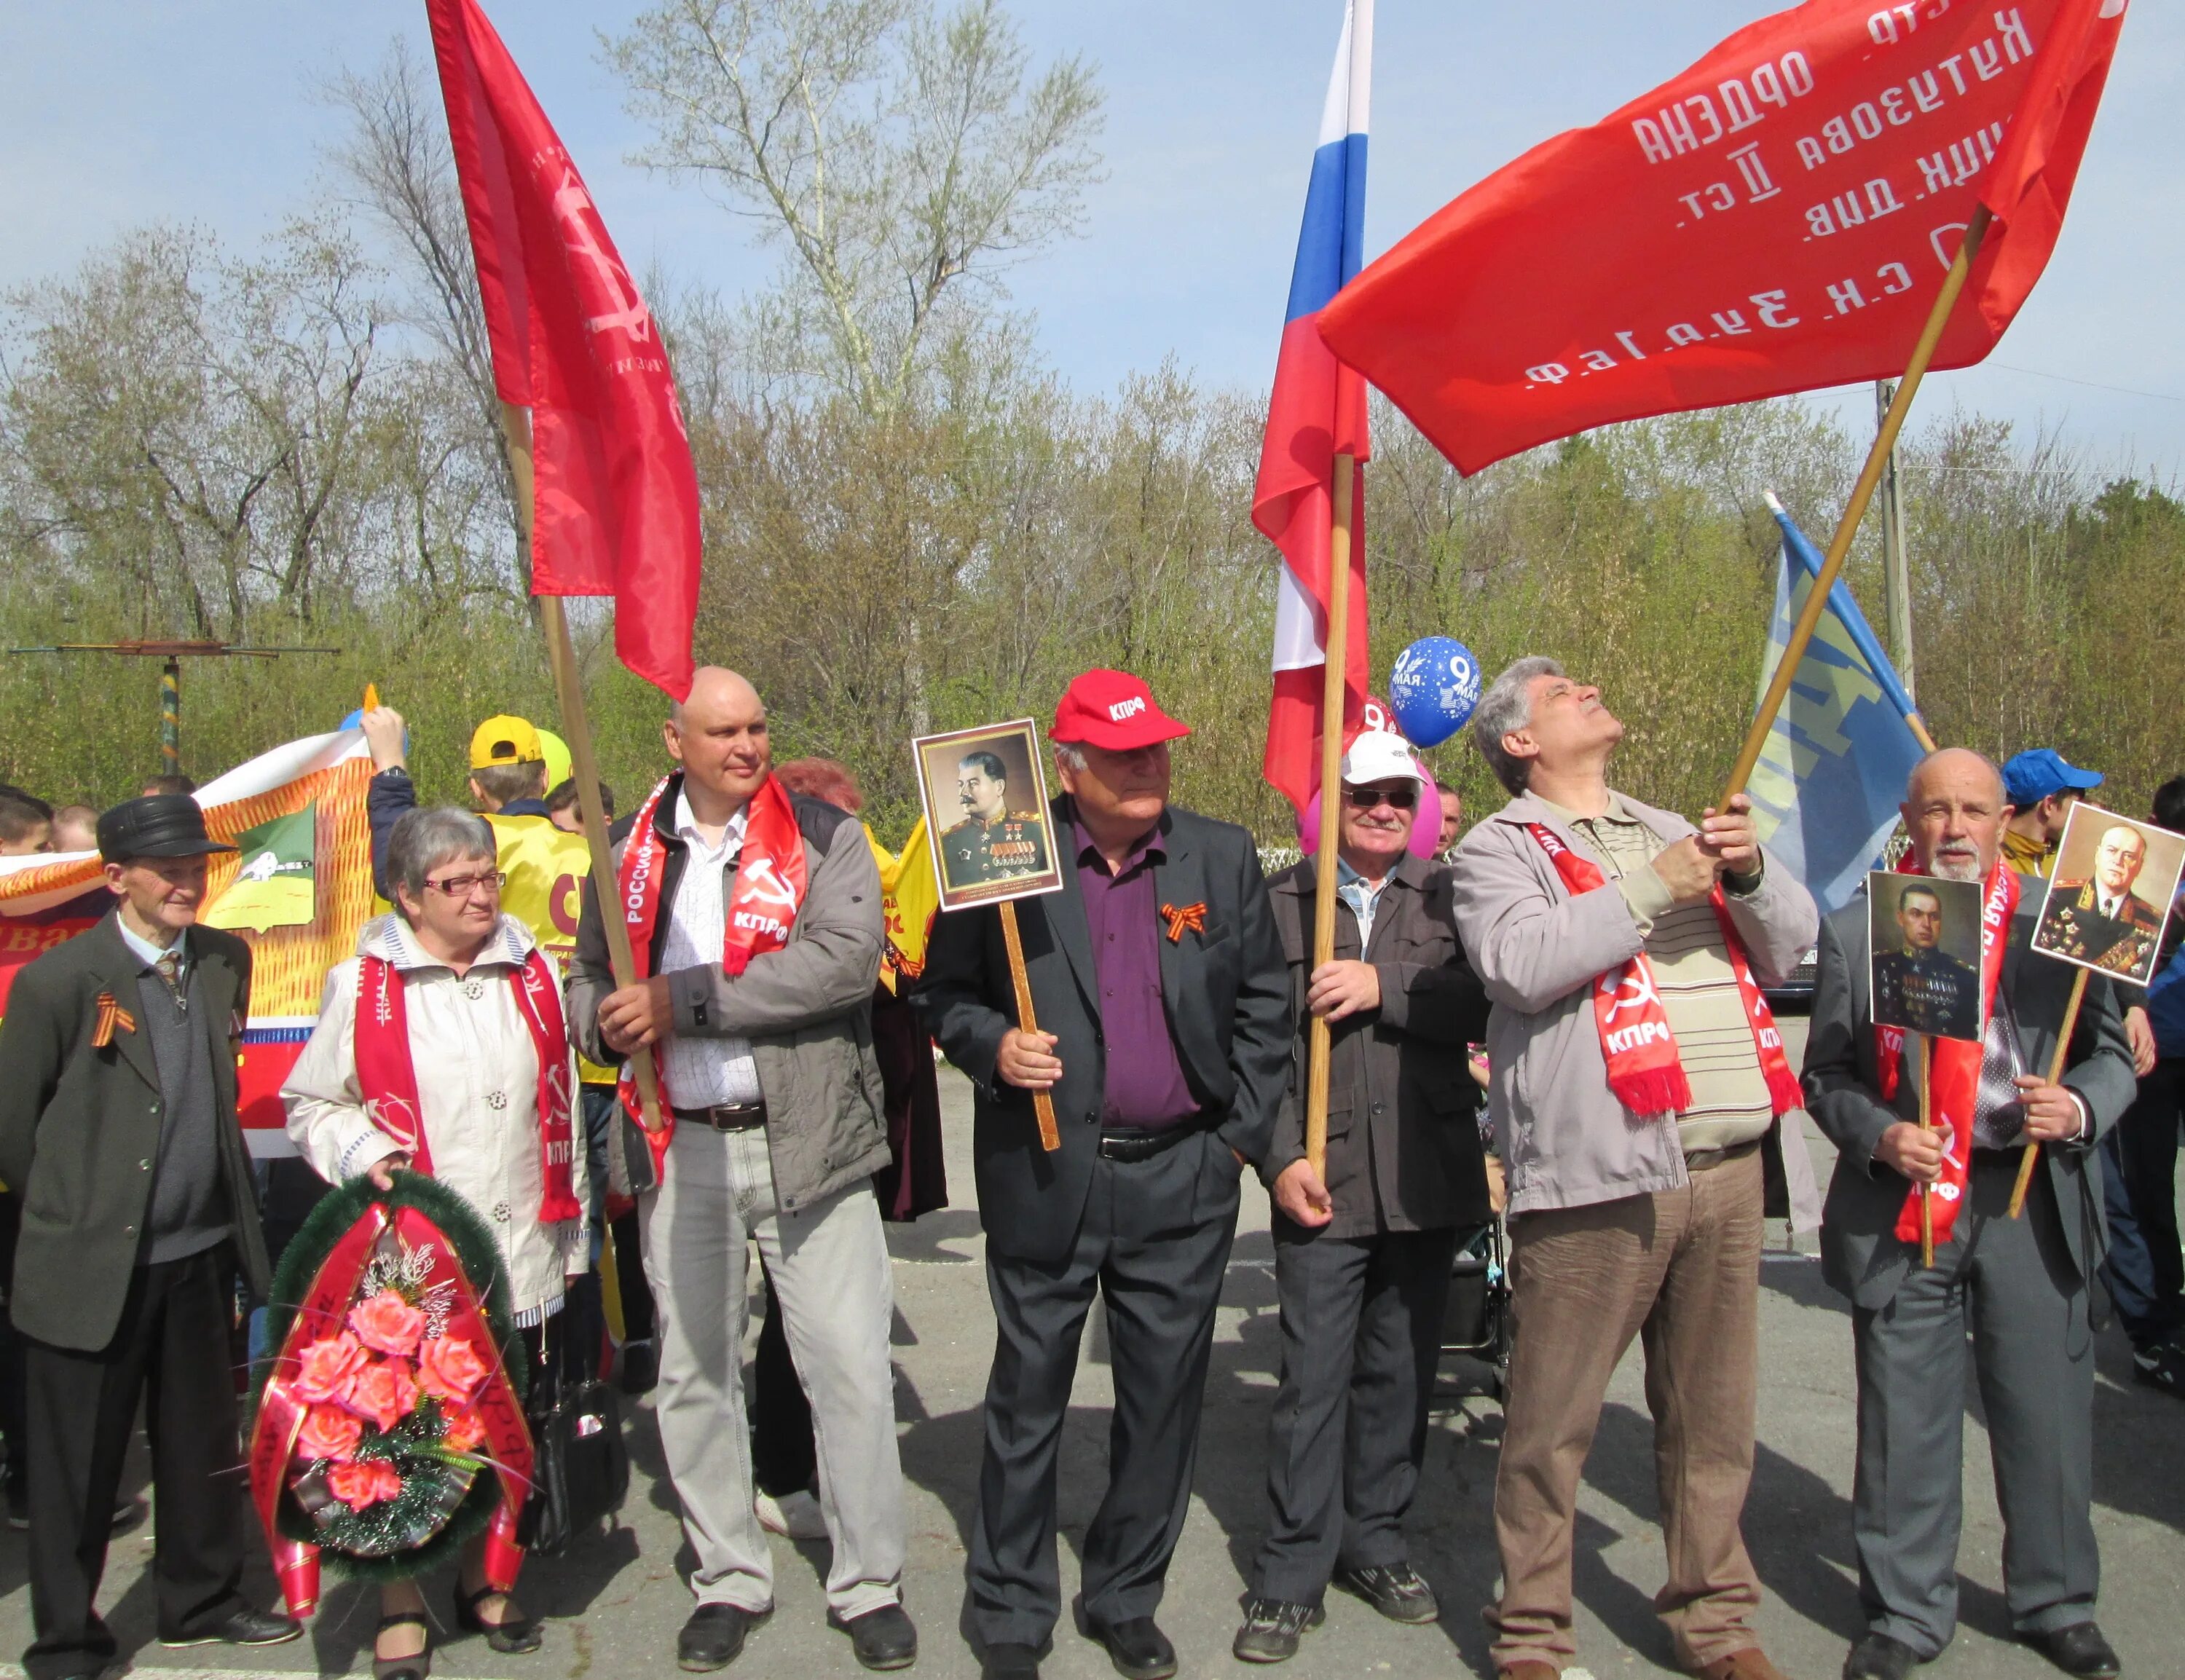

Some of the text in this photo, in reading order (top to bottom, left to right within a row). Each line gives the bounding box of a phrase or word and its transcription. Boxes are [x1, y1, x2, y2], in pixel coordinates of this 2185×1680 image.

[1393, 649, 1411, 682] 9
[1394, 674, 1420, 686] МАЯ
[1449, 656, 1470, 690] 9
[1109, 695, 1146, 722] КПРФ
[1456, 683, 1478, 703] МАЯ
[734, 911, 788, 942] КПРФ
[1607, 1021, 1669, 1055] КПРФ
